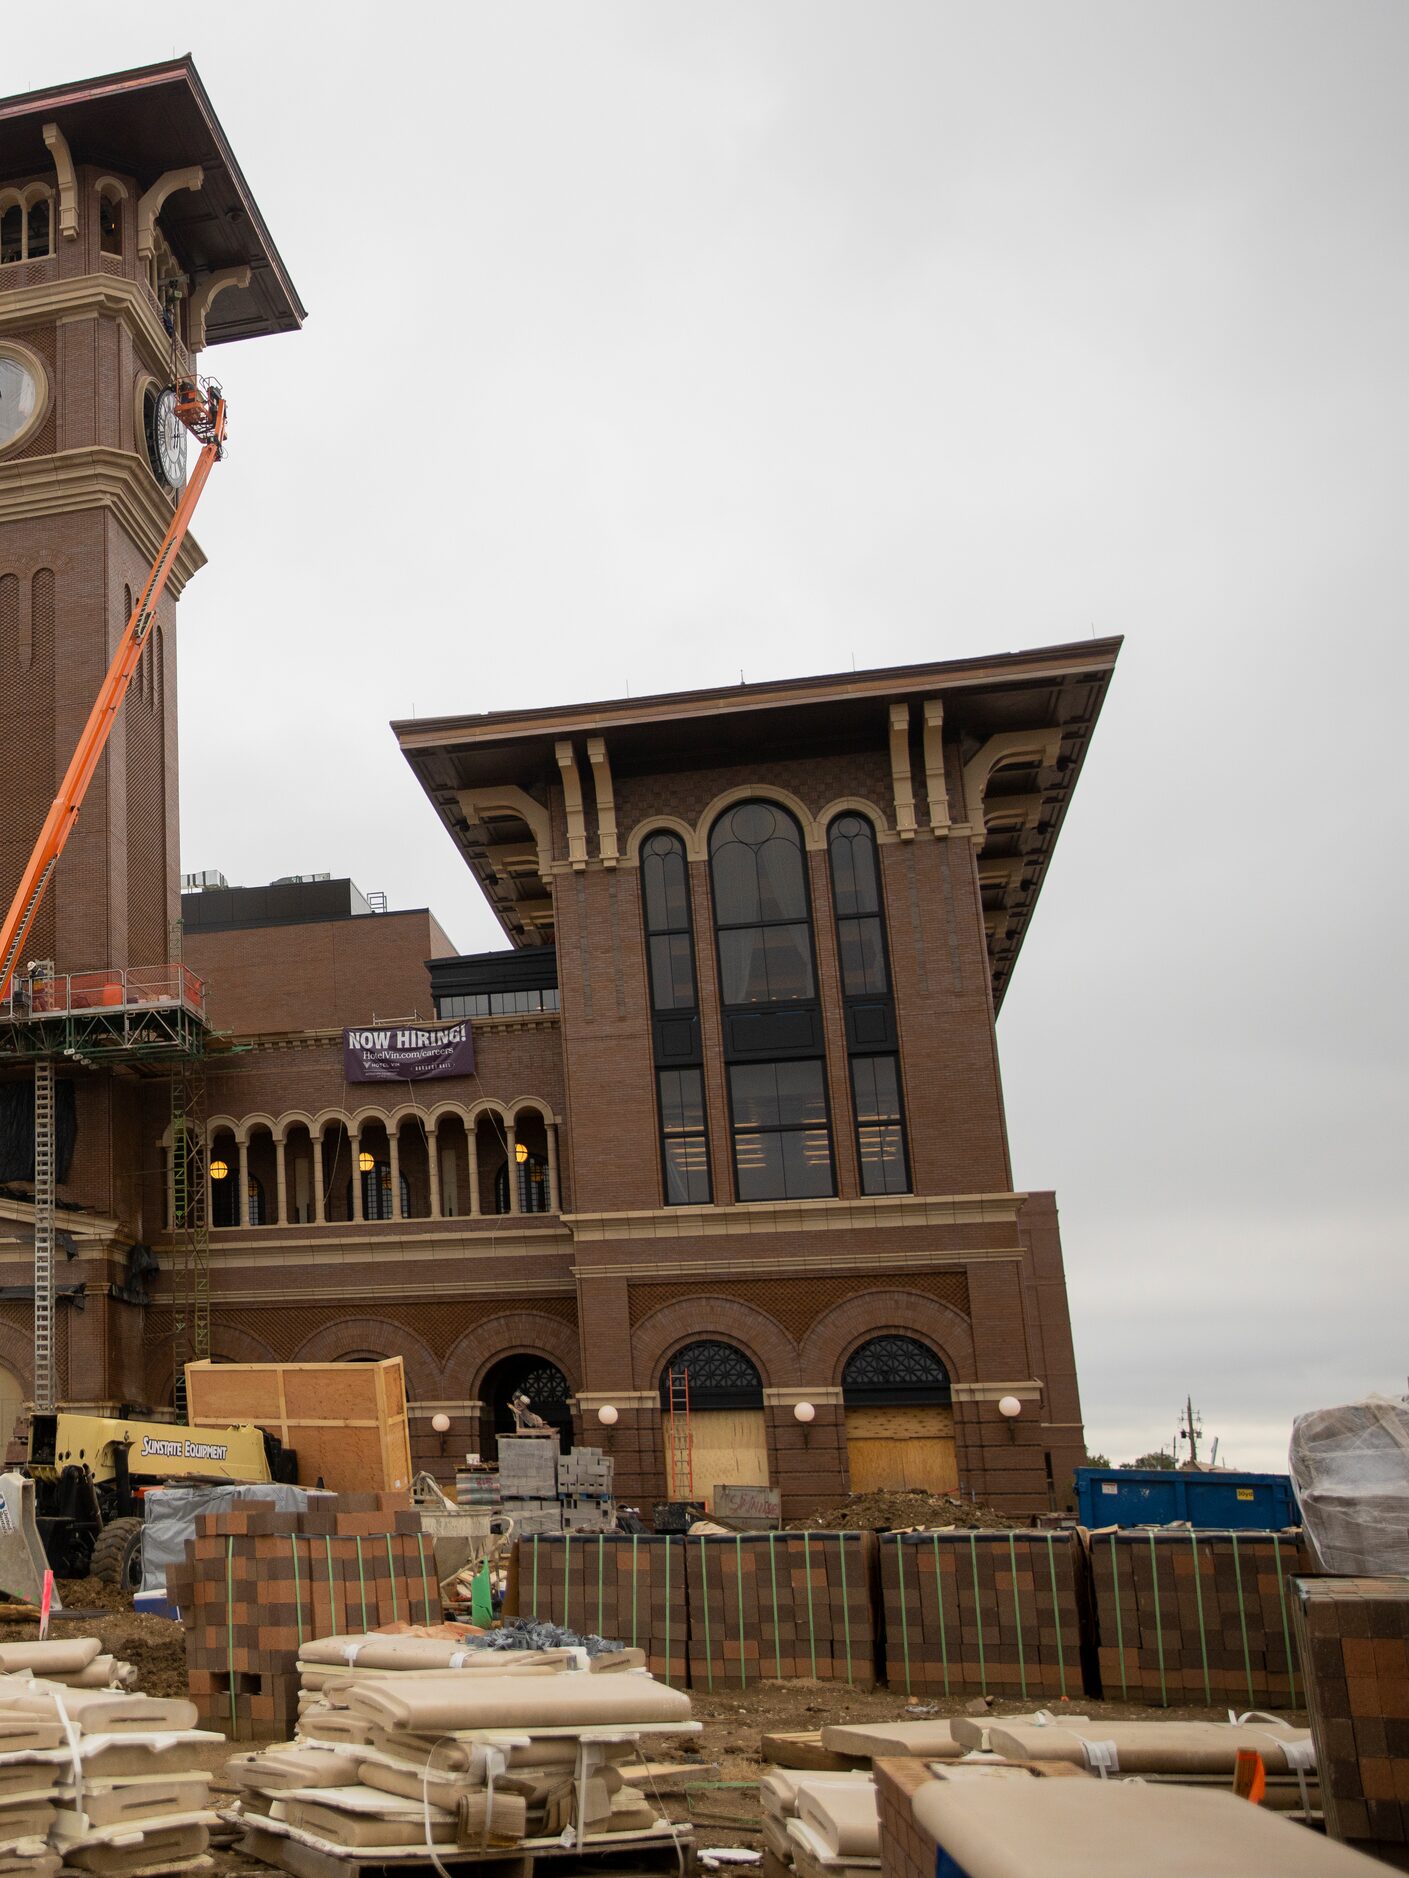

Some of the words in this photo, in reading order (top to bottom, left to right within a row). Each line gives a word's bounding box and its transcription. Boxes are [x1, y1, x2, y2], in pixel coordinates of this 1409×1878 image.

[349, 1031, 391, 1049] NOW
[396, 1023, 467, 1048] HIRING!
[363, 1046, 455, 1060] HotelVin.com/careers
[141, 1436, 182, 1457] SUNSTATE
[184, 1440, 227, 1460] EQUIPMENT
[2, 1509, 12, 1531] United
